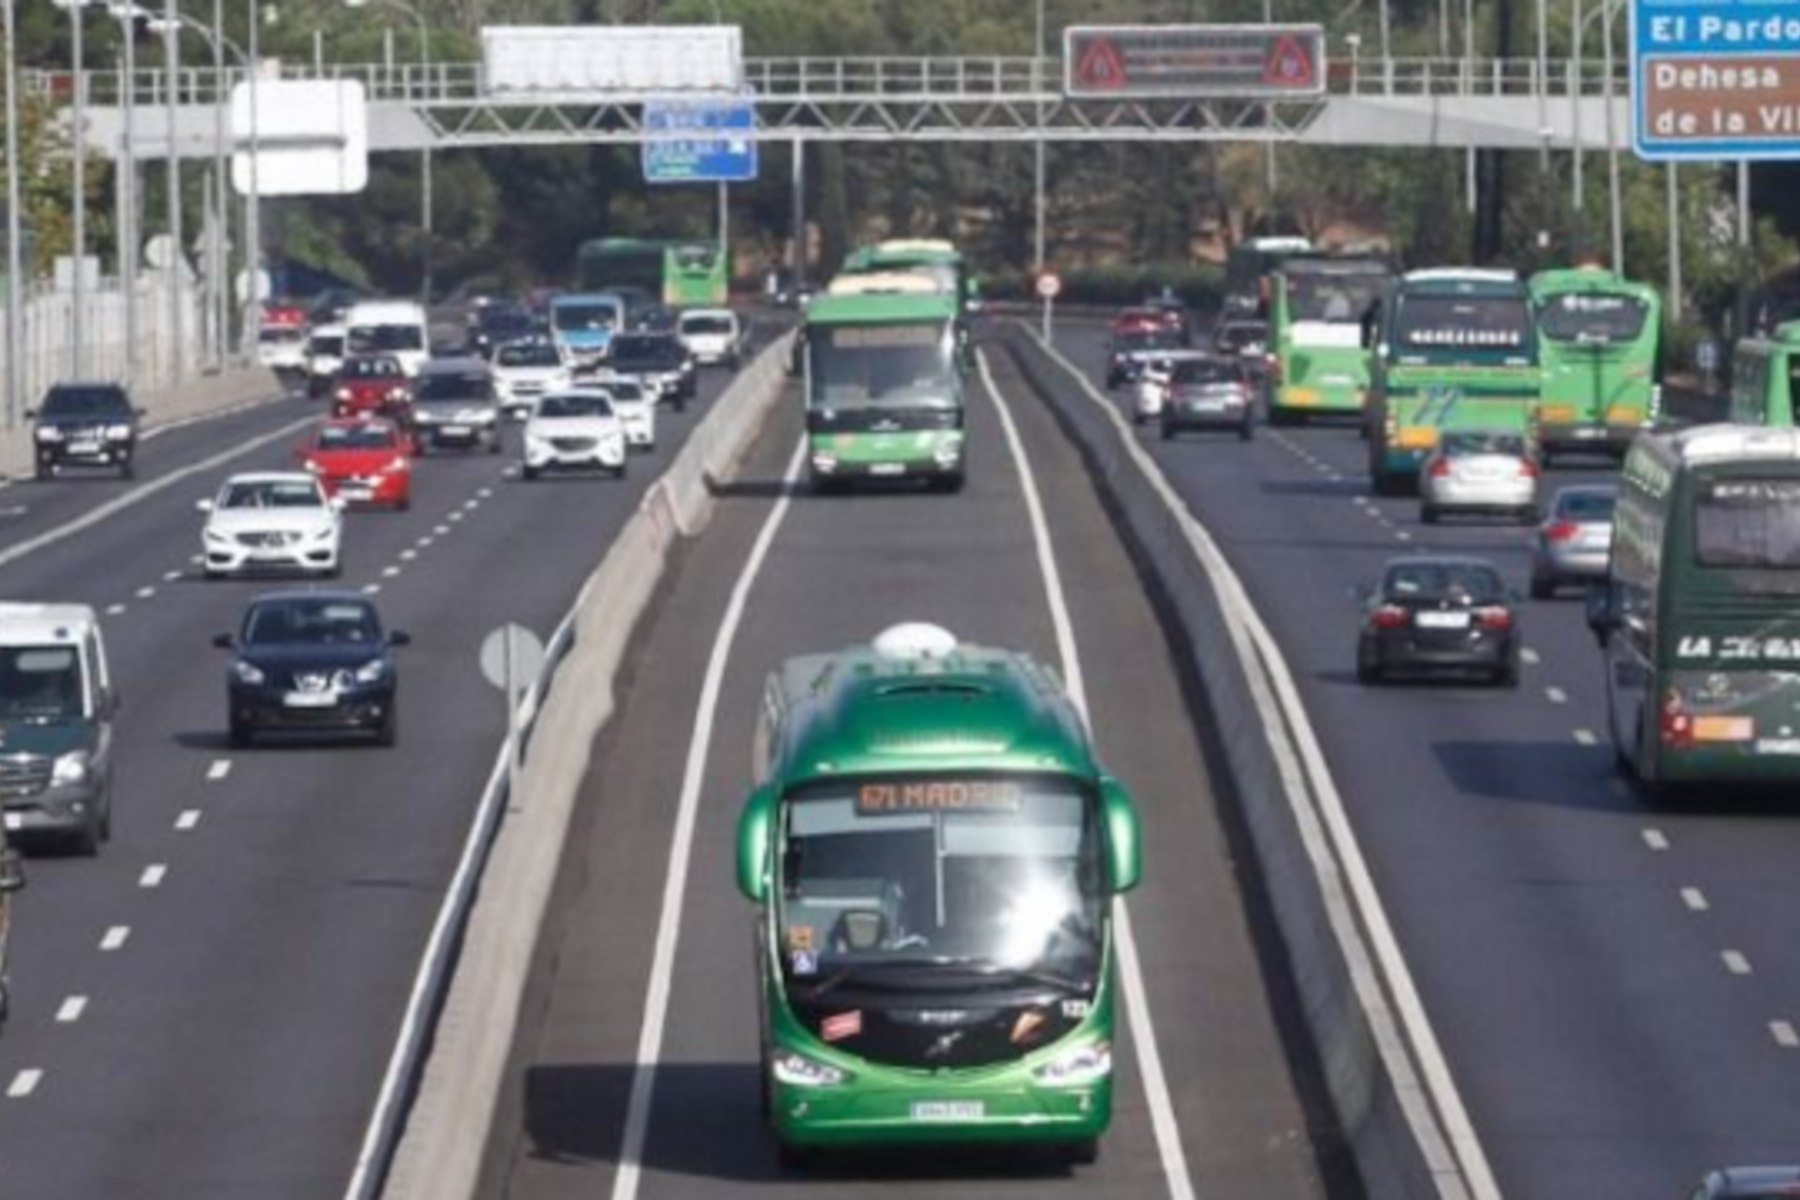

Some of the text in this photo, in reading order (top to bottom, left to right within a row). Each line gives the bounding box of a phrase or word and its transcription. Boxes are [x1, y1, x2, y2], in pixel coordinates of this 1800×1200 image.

[1651, 15, 1800, 42] El Pardo
[1655, 62, 1780, 90] Dehesa
[1656, 108, 1698, 134] de
[1712, 107, 1746, 132] la
